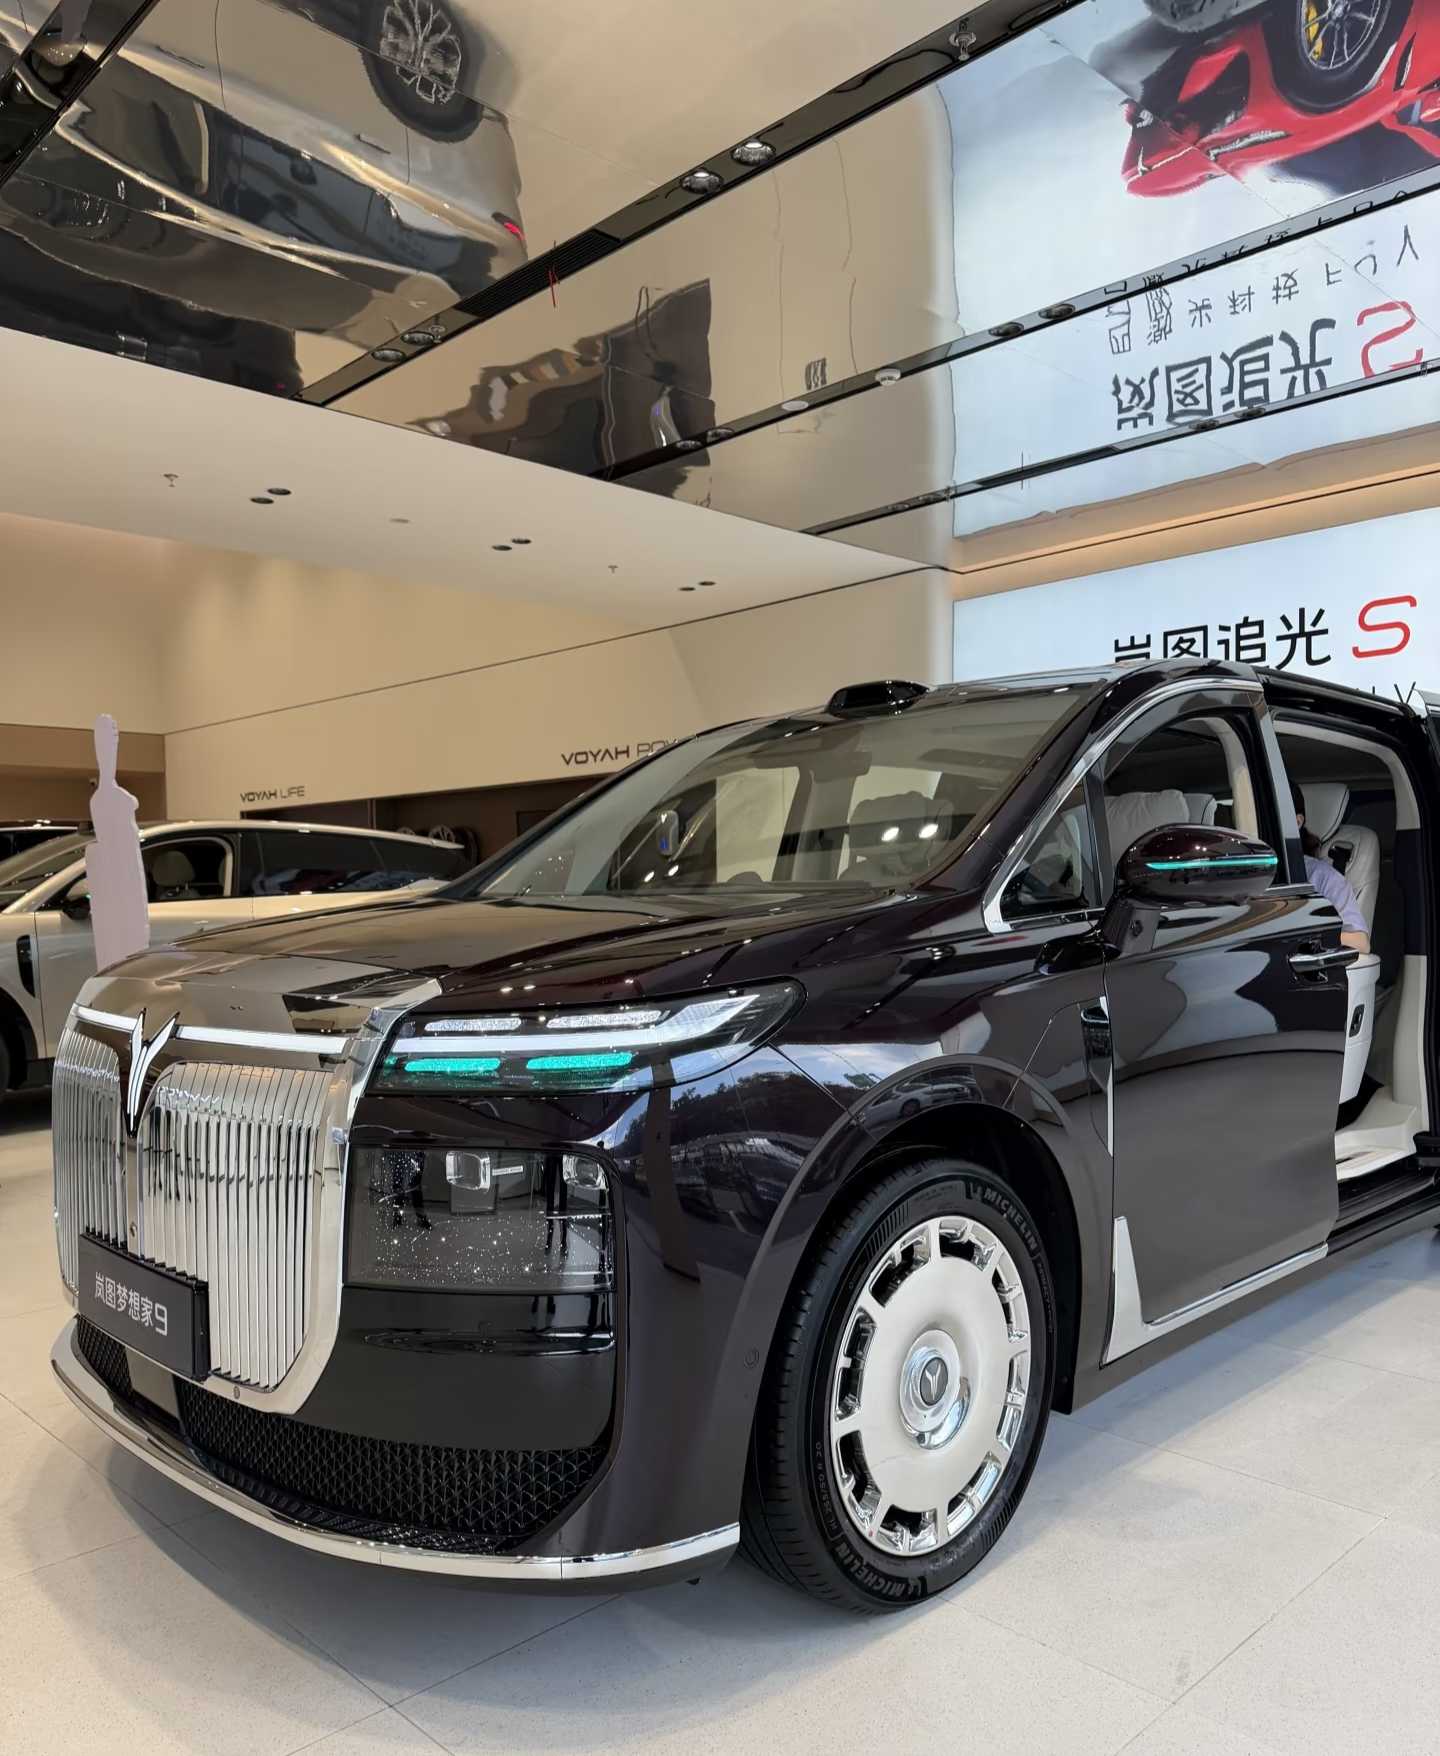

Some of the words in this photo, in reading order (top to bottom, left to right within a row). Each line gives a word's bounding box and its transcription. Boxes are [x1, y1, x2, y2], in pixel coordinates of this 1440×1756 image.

[1352, 595, 1417, 659] S
[561, 745, 630, 766] VOYAH
[240, 788, 277, 803] VOYAH
[280, 785, 305, 799] LIFE
[983, 1187, 1039, 1251] MICHELIN
[94, 1271, 168, 1337] 岚图梦想家9
[834, 1541, 906, 1598] MICHELIN
